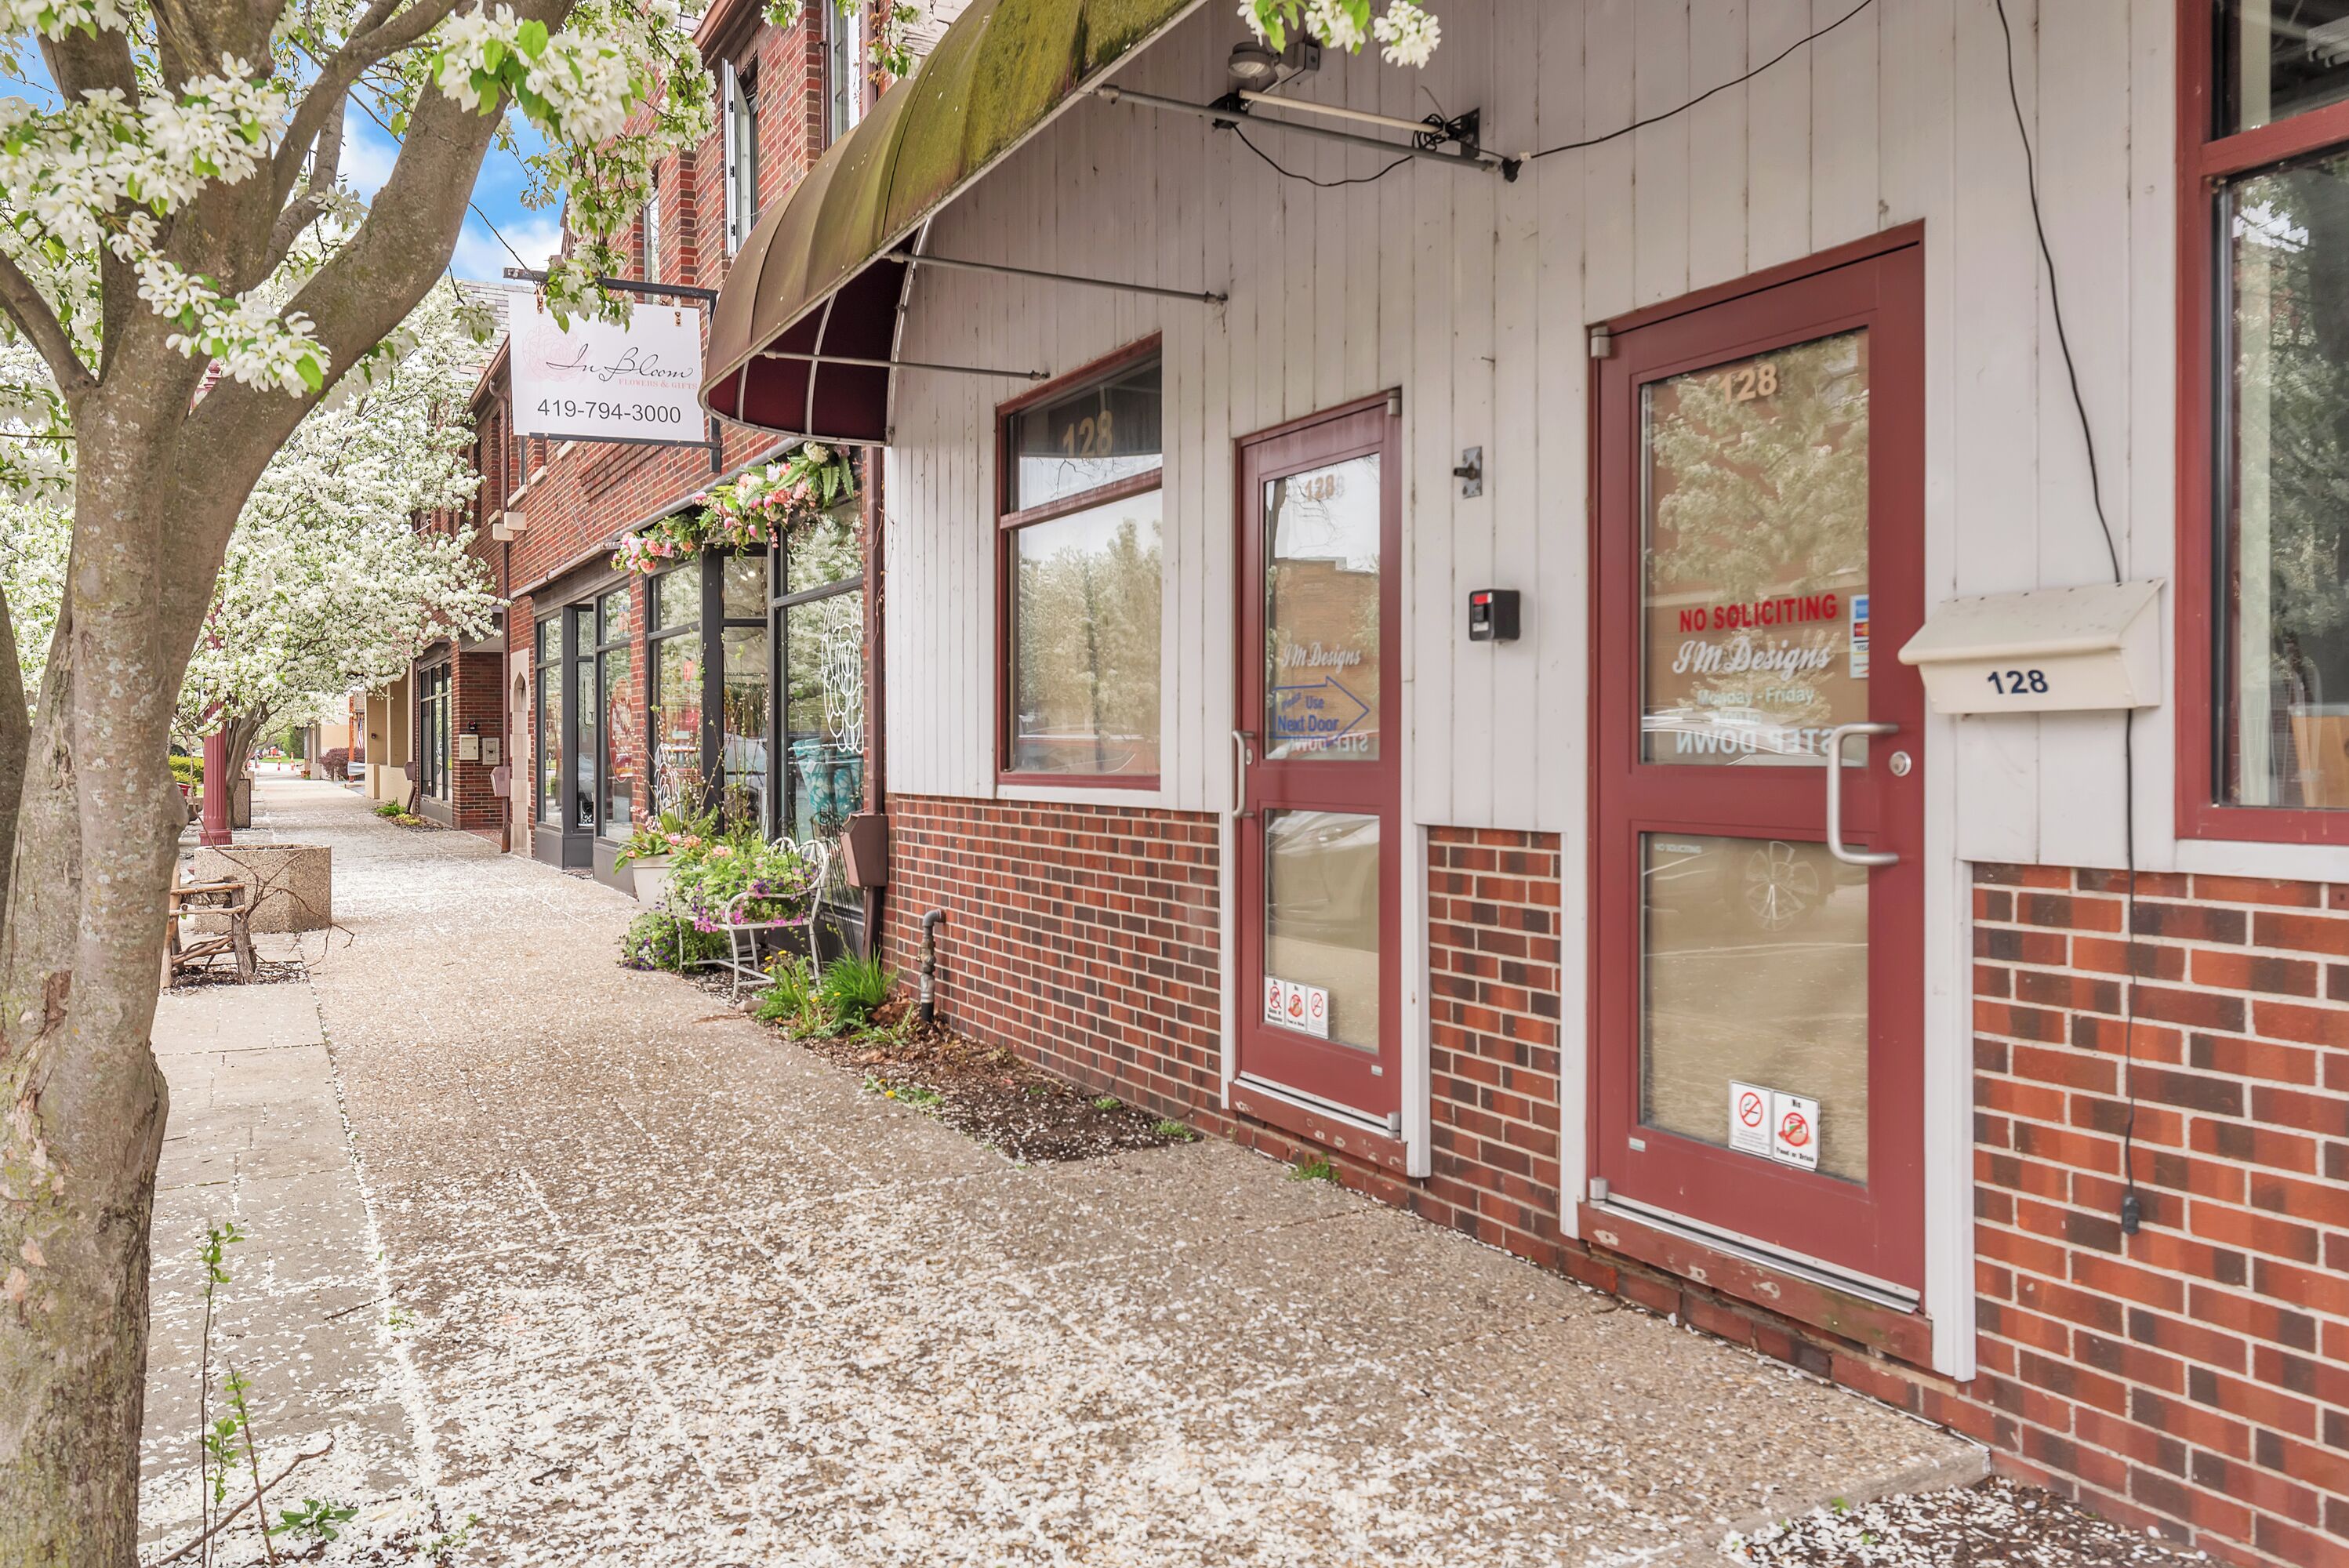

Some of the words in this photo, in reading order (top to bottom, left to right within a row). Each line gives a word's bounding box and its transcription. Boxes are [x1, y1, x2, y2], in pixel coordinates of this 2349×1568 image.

[546, 343, 600, 372] In
[599, 347, 693, 382] Bloom
[619, 378, 659, 387] FLOWERS
[660, 379, 670, 388] &
[1719, 363, 1778, 405] 128
[537, 398, 681, 423] 419-794-3000
[1062, 410, 1113, 459] 128
[1305, 474, 1335, 503] 128
[1679, 607, 1707, 633] NO
[1713, 593, 1838, 630] SOLICITING
[1307, 641, 1361, 675] Designs
[1723, 635, 1832, 681] Designs
[1765, 687, 1815, 705] Friday
[1987, 669, 2049, 695] 128
[1305, 695, 1325, 710] Use
[1277, 714, 1305, 732] Next
[1307, 714, 1339, 732] Door
